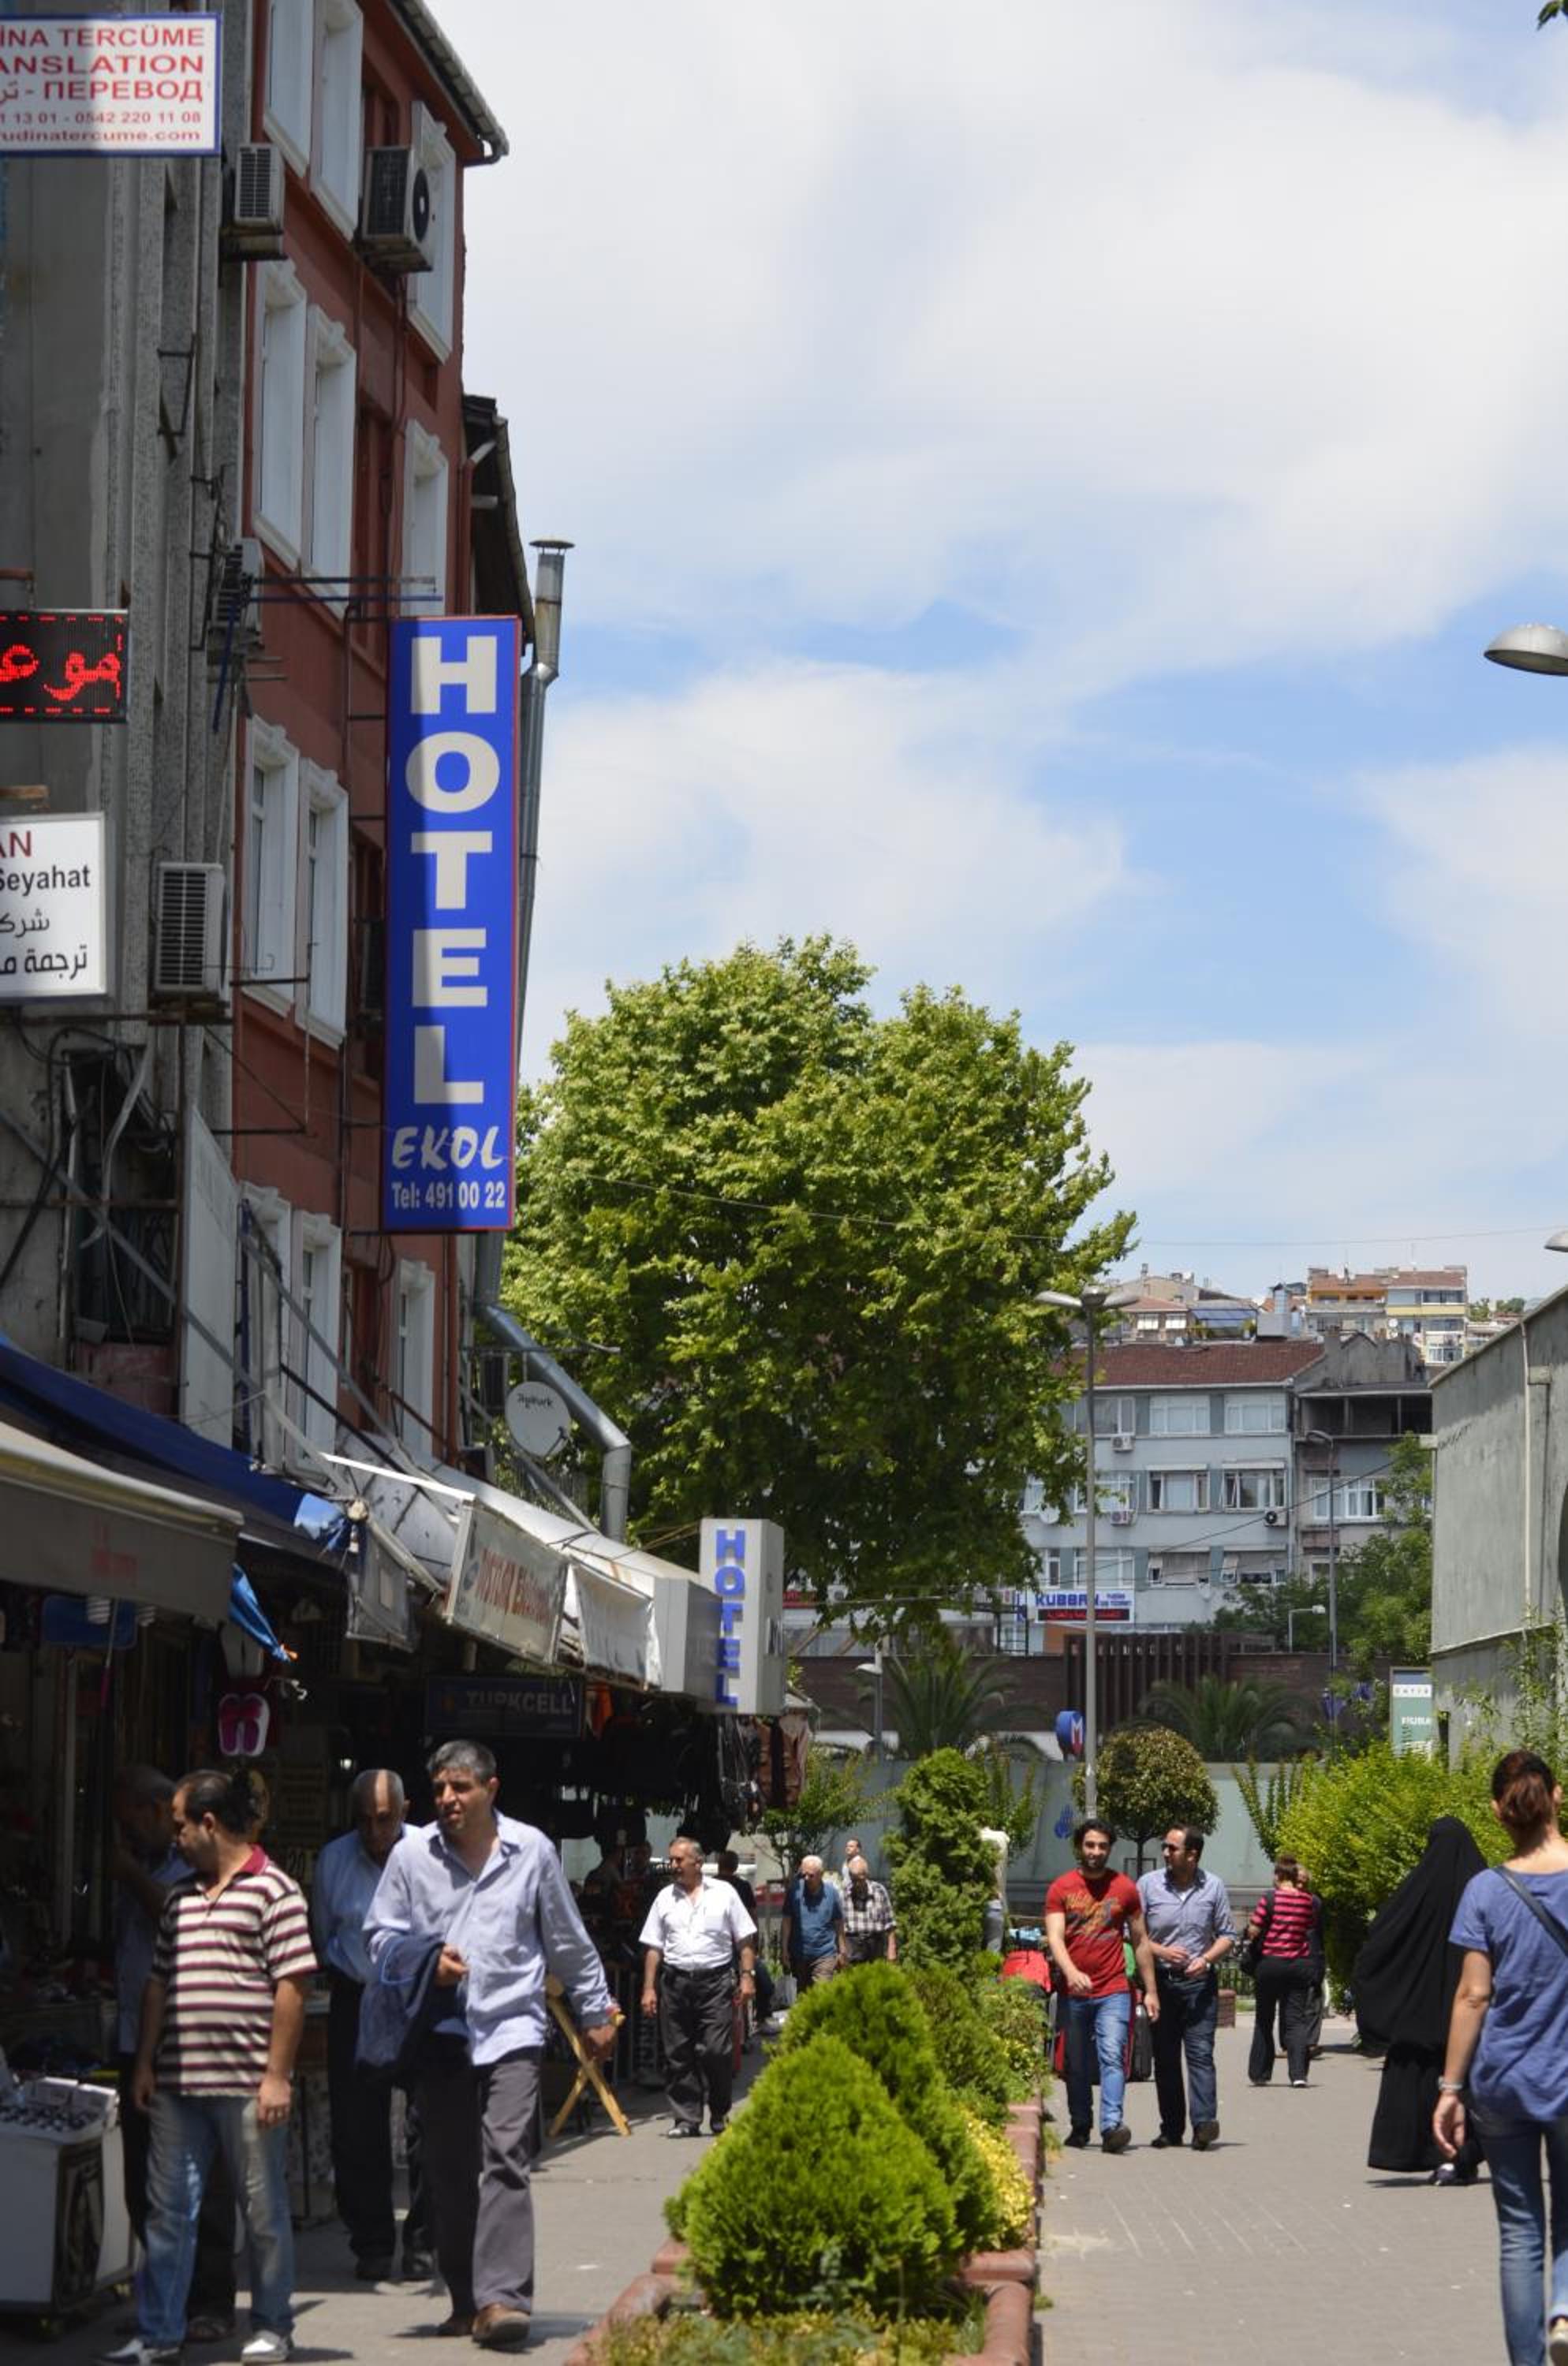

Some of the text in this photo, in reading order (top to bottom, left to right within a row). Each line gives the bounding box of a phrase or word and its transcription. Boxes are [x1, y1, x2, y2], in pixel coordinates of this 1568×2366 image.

[58, 24, 204, 47] TERCÜME
[44, 80, 203, 103] ПЕРЕВОД
[38, 112, 56, 124] 01
[121, 111, 151, 124] 220
[159, 111, 174, 124] 11
[0, 129, 200, 141] udinatercume.com
[0, 830, 32, 858] N
[405, 635, 500, 1104] HOTEL
[24, 944, 88, 980] ترجمة
[392, 1125, 503, 1170] EKOL
[390, 1181, 505, 1209] Tel: 491 00 22
[715, 1529, 745, 1705] HOTEL
